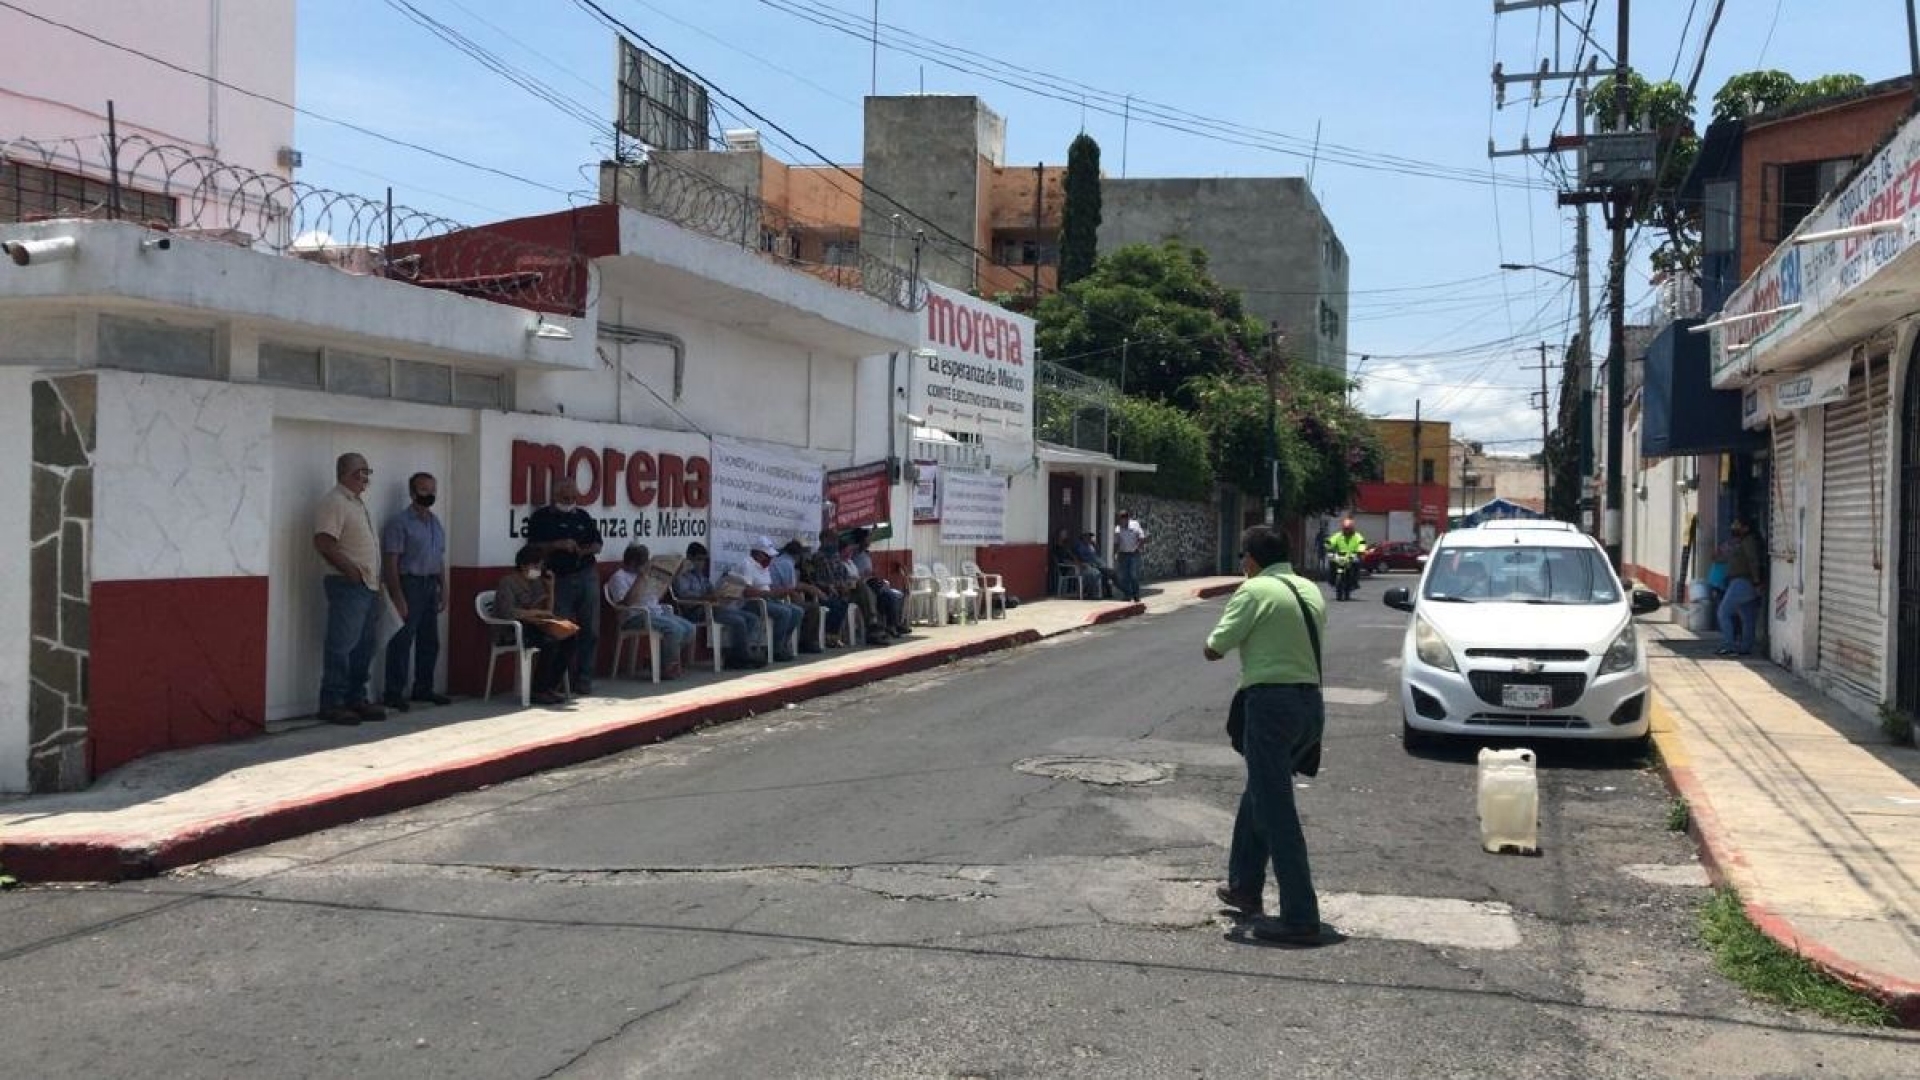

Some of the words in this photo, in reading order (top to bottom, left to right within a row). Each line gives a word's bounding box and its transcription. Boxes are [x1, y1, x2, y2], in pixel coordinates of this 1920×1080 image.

[1882, 148, 1893, 185] DE
[927, 294, 1024, 367] morena
[928, 357, 939, 374] La
[941, 358, 983, 384] esperanza
[985, 363, 996, 387] de
[511, 440, 711, 508] morena
[510, 509, 529, 539] La
[634, 512, 651, 537] de
[657, 510, 706, 538] México
